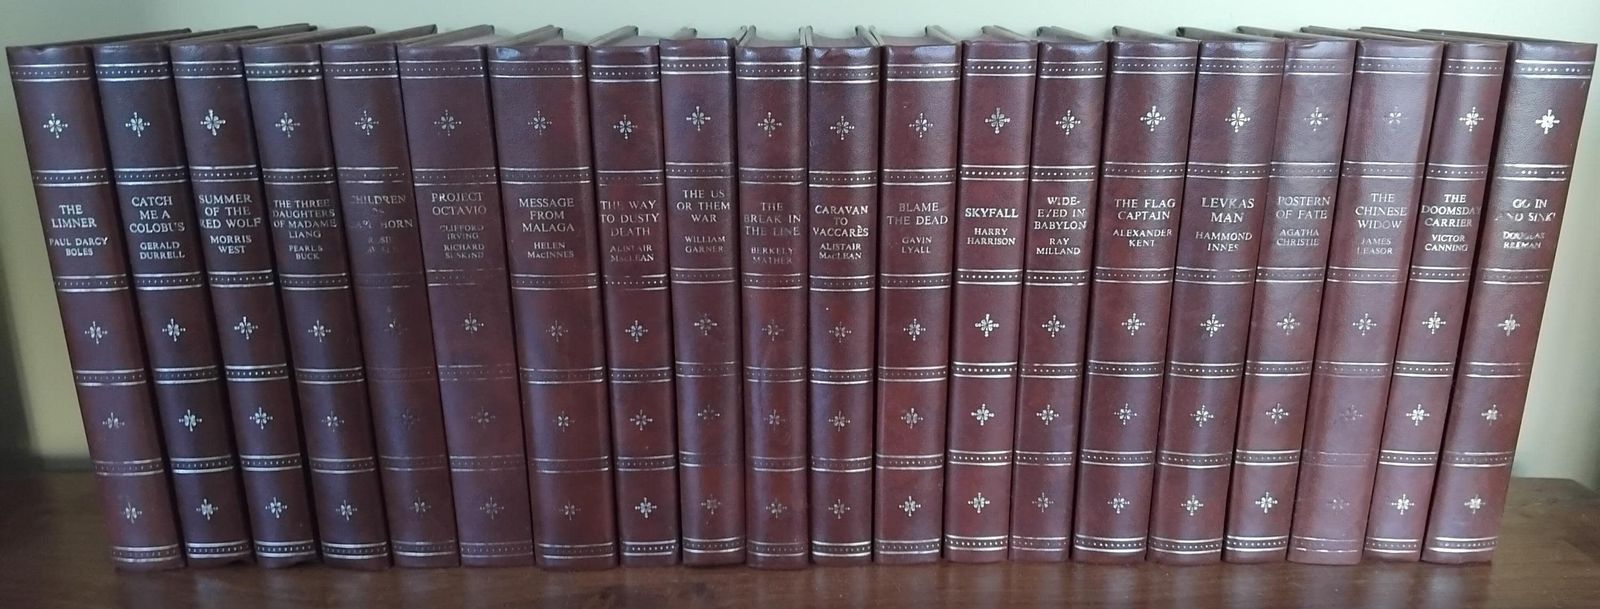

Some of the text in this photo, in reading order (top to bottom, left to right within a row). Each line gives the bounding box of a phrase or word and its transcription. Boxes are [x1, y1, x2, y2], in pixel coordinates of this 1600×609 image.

[432, 192, 483, 202] PROJECT
[683, 190, 725, 198] THE US
[1370, 193, 1395, 203] THE
[1444, 194, 1466, 203] THE
[131, 196, 173, 207] CATCH
[199, 194, 252, 204] SUMMER
[274, 199, 330, 208] THE THREE
[519, 198, 574, 208] MESSAGE
[1114, 198, 1176, 208] THE FLAG
[1201, 197, 1254, 208] LEVKAS
[1278, 196, 1331, 206] POSTERN
[1535, 199, 1548, 208] IN
[629, 200, 656, 209] WAY
[676, 202, 730, 210] OR THEM
[761, 202, 782, 211] THE
[899, 202, 939, 212] BLAME
[59, 205, 82, 215] THE
[139, 210, 171, 219] ME A
[205, 207, 251, 216] OF THE
[273, 209, 335, 218] DAUGHTERS
[432, 206, 486, 216] OCTAVIO
[815, 205, 869, 215] CARAVAN
[965, 208, 1019, 218] SKYFALL
[1072, 209, 1086, 217] IN
[1276, 210, 1327, 219] OF FATE
[1355, 206, 1408, 216] CHINESE
[530, 211, 564, 220] FROM
[600, 214, 615, 223] TO
[691, 214, 717, 222] WAR
[744, 214, 801, 223] BREAK IN
[887, 215, 948, 225] THE DEAD
[1118, 211, 1170, 220] CAPTAIN
[1211, 212, 1244, 222] MAN
[51, 218, 97, 228] LIMNER
[201, 217, 261, 228] RED WOLF
[288, 219, 336, 228] MADAME
[834, 217, 848, 225] TO
[1034, 221, 1087, 230] BABYLON
[1358, 220, 1402, 229] WIDOW
[1424, 218, 1472, 227] CARRIER
[130, 222, 185, 233] COLOBUS
[522, 223, 574, 232] MALAGA
[611, 227, 650, 236] DEATH
[745, 226, 800, 236] THE LINE
[813, 225, 869, 237] VACCARÈS
[210, 235, 252, 244] MORRIS
[902, 236, 932, 244] GAVIN
[1195, 232, 1252, 240] HAMMOND
[1432, 234, 1465, 242] VICTOR
[49, 237, 108, 246] PAUL DARCY
[140, 241, 180, 250] GERALD
[1129, 239, 1155, 247] KENT
[1277, 238, 1319, 246] CHRISTIE
[66, 248, 93, 256] BOLES
[219, 245, 246, 254] WEST
[902, 246, 931, 254] LYALL
[1036, 247, 1080, 255] MILLAND
[1208, 243, 1239, 252] INNES
[1357, 247, 1393, 255] LEASOR
[1424, 244, 1468, 252] CANNING
[140, 251, 185, 259] DURRELL
